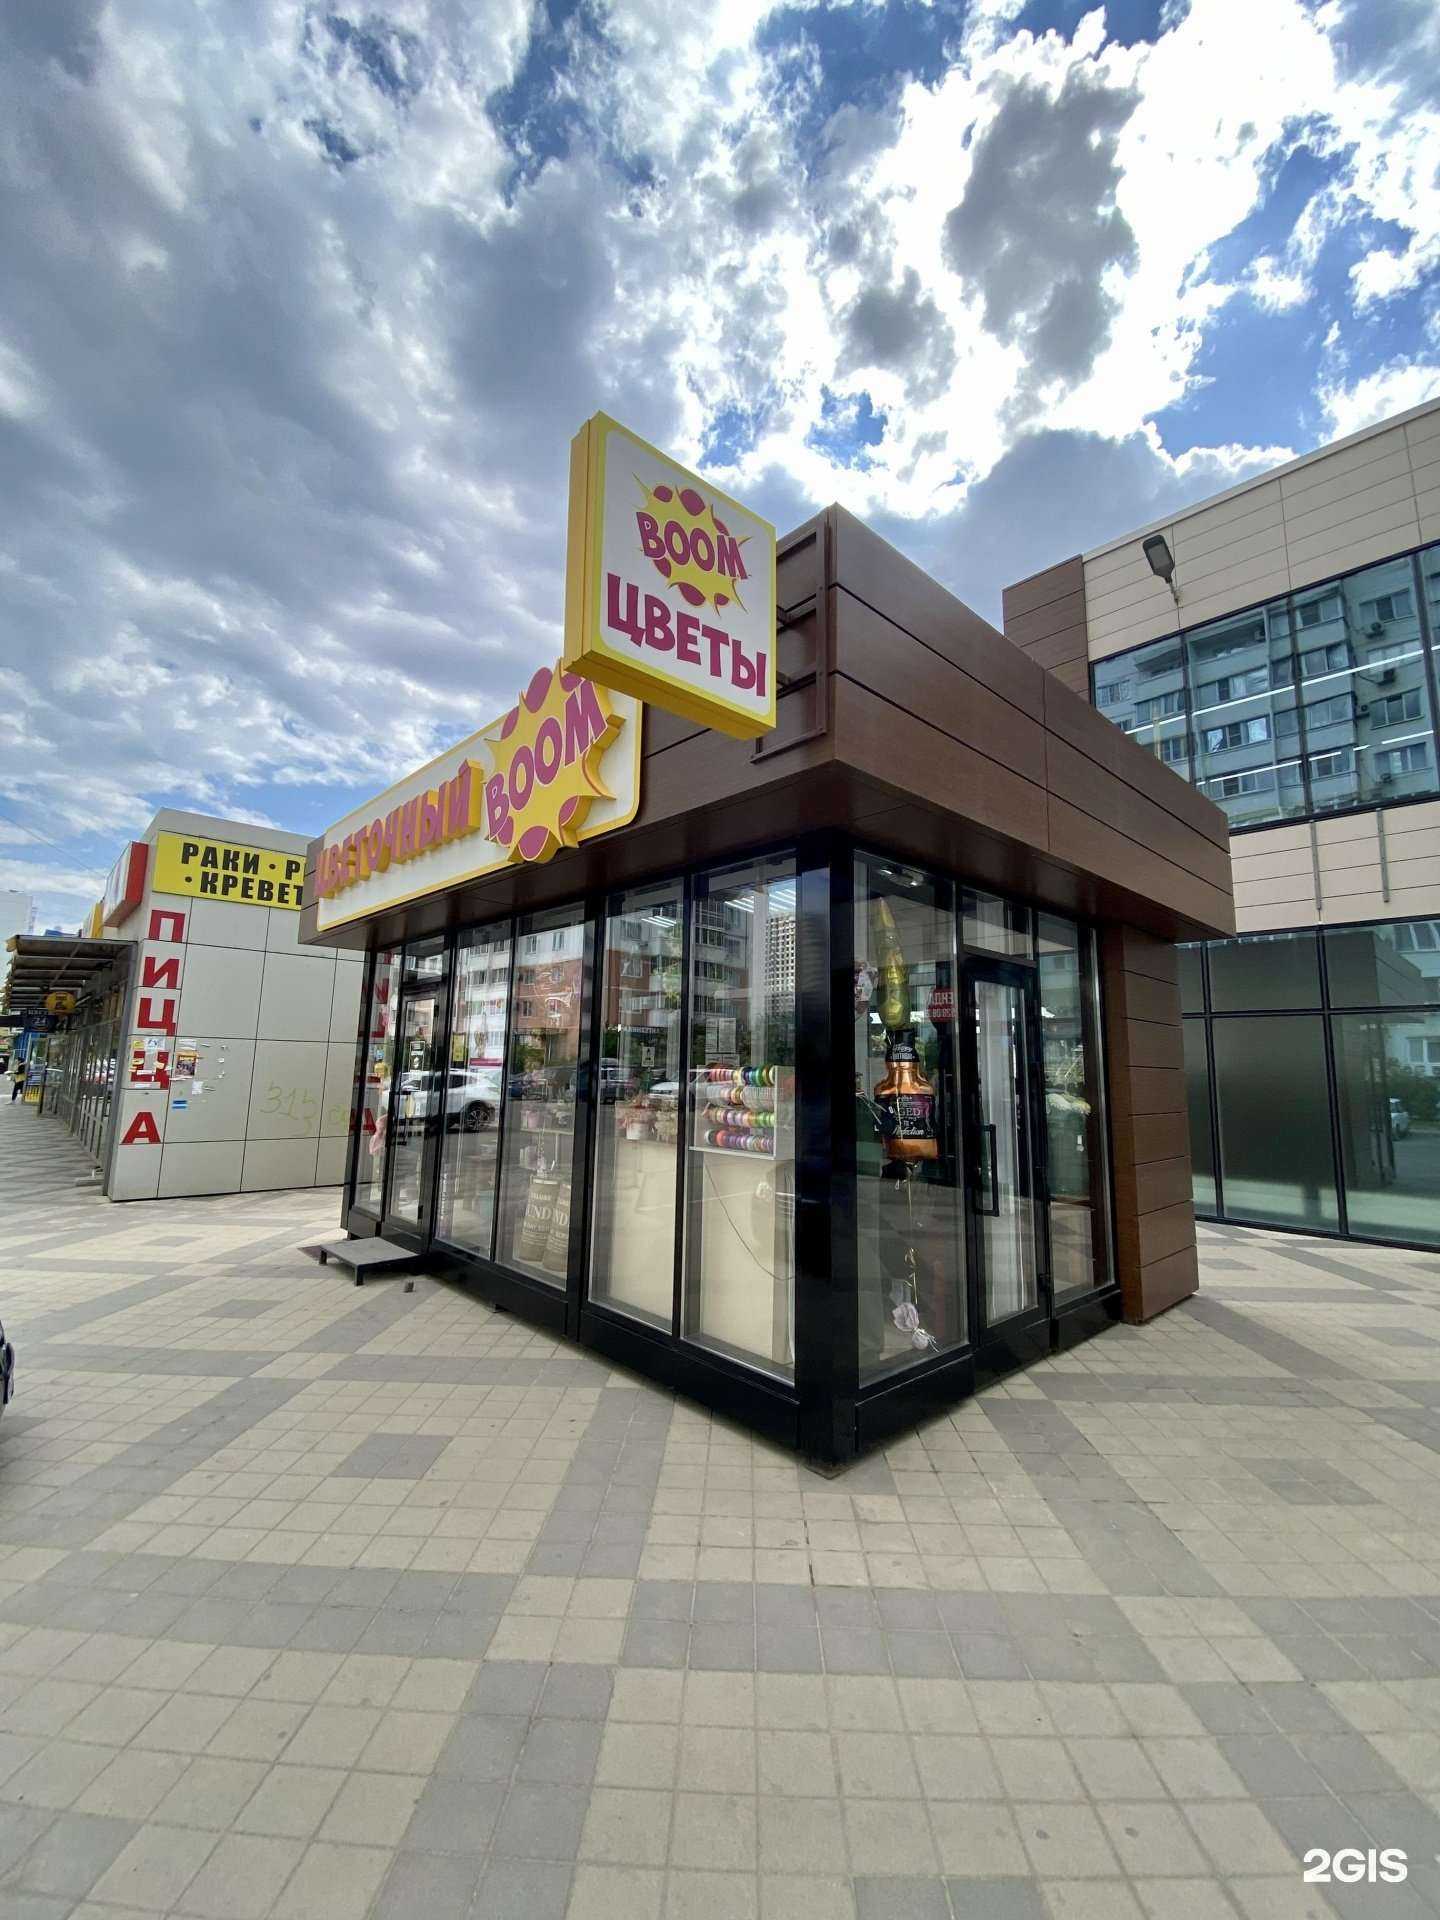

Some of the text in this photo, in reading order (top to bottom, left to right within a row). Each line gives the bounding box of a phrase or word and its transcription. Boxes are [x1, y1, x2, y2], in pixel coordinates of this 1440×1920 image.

[636, 511, 748, 580] BOOM
[607, 573, 767, 697] ЦВЕТЫ
[314, 678, 608, 898] ЦВЕТОЧНЫЙ BOOM
[181, 842, 260, 875] РАКИ
[200, 871, 304, 906] КРЕВЕТ
[121, 909, 186, 1145] ПИЦЦА
